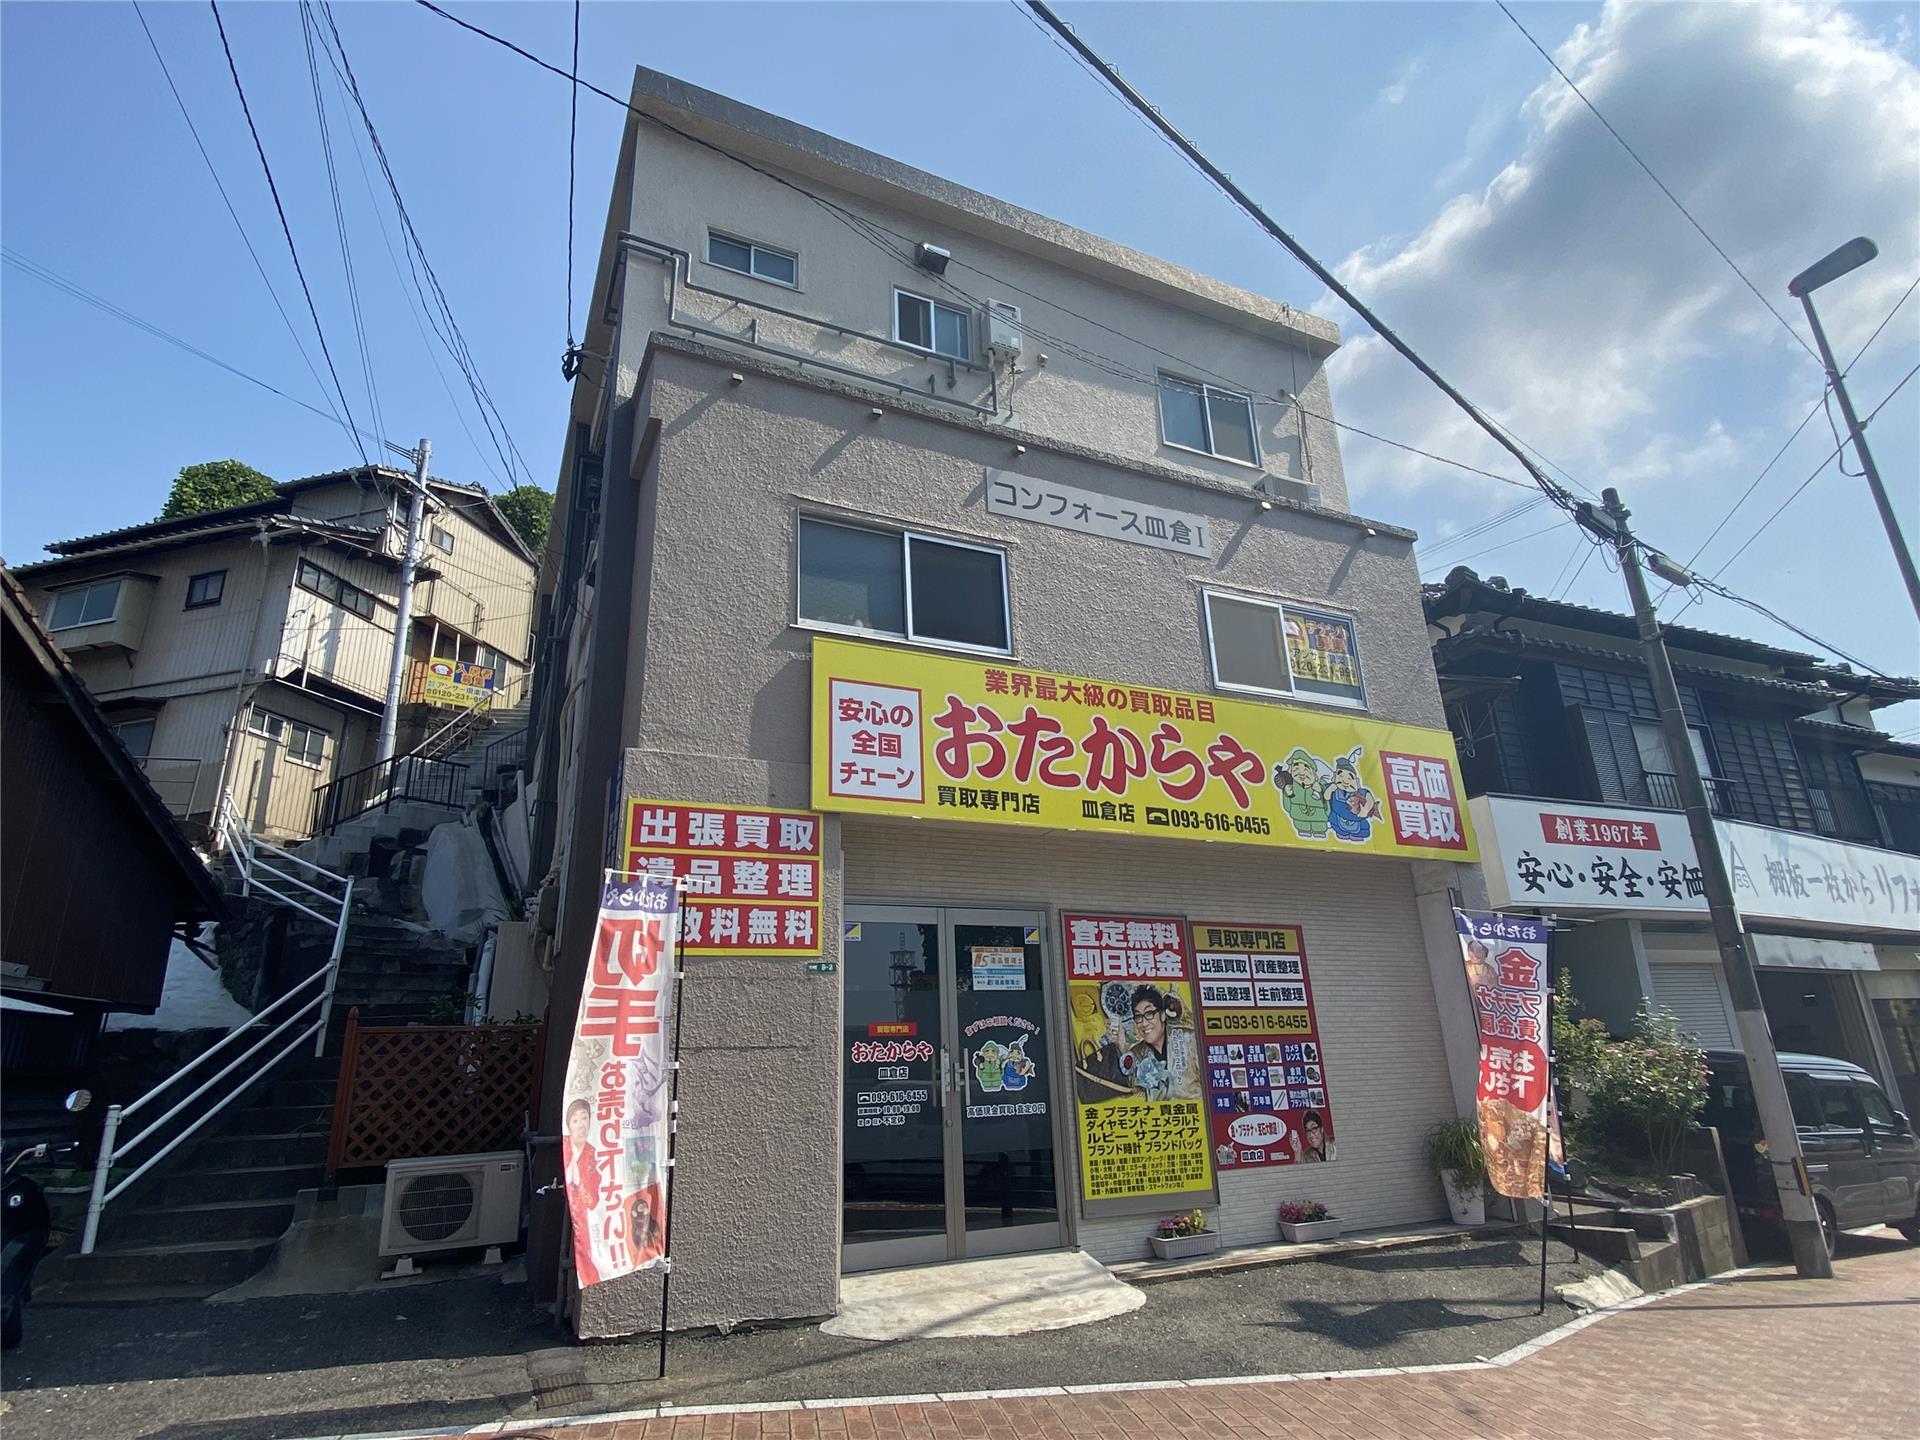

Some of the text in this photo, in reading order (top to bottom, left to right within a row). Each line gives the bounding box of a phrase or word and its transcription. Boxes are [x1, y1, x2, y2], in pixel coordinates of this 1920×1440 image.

[985, 669, 1216, 723] 業界最大級の買取品目
[838, 697, 914, 727] 安心の
[851, 731, 902, 758] 全国
[933, 695, 1266, 808] おたからや
[840, 761, 915, 789] チェーン
[1389, 757, 1449, 800] 高価
[937, 786, 1271, 836] 買取専門店 皿倉店 093-616-6455
[1400, 797, 1462, 843] 買取
[640, 809, 814, 851] 出張買取
[1554, 817, 1650, 847] 創業1967年
[637, 857, 813, 898] 遺品整理
[1070, 920, 1180, 949] 査定無料
[1207, 929, 1286, 950] 買取専門店
[1072, 949, 1183, 977] 即日現金
[1200, 958, 1300, 975] 出張買取 資産整理
[1203, 986, 1305, 1002] 遺品整理 生前整理
[1223, 1015, 1308, 1030] 093-616-6455
[852, 1040, 934, 1063] おたからや
[871, 1090, 928, 1104] 093-616-6455
[1085, 1103, 1199, 1120] 金 プラチナ 貴金属
[1086, 1114, 1200, 1132] ダイヤモンド エメラルド
[1087, 1127, 1200, 1144] ルビー サファイア
